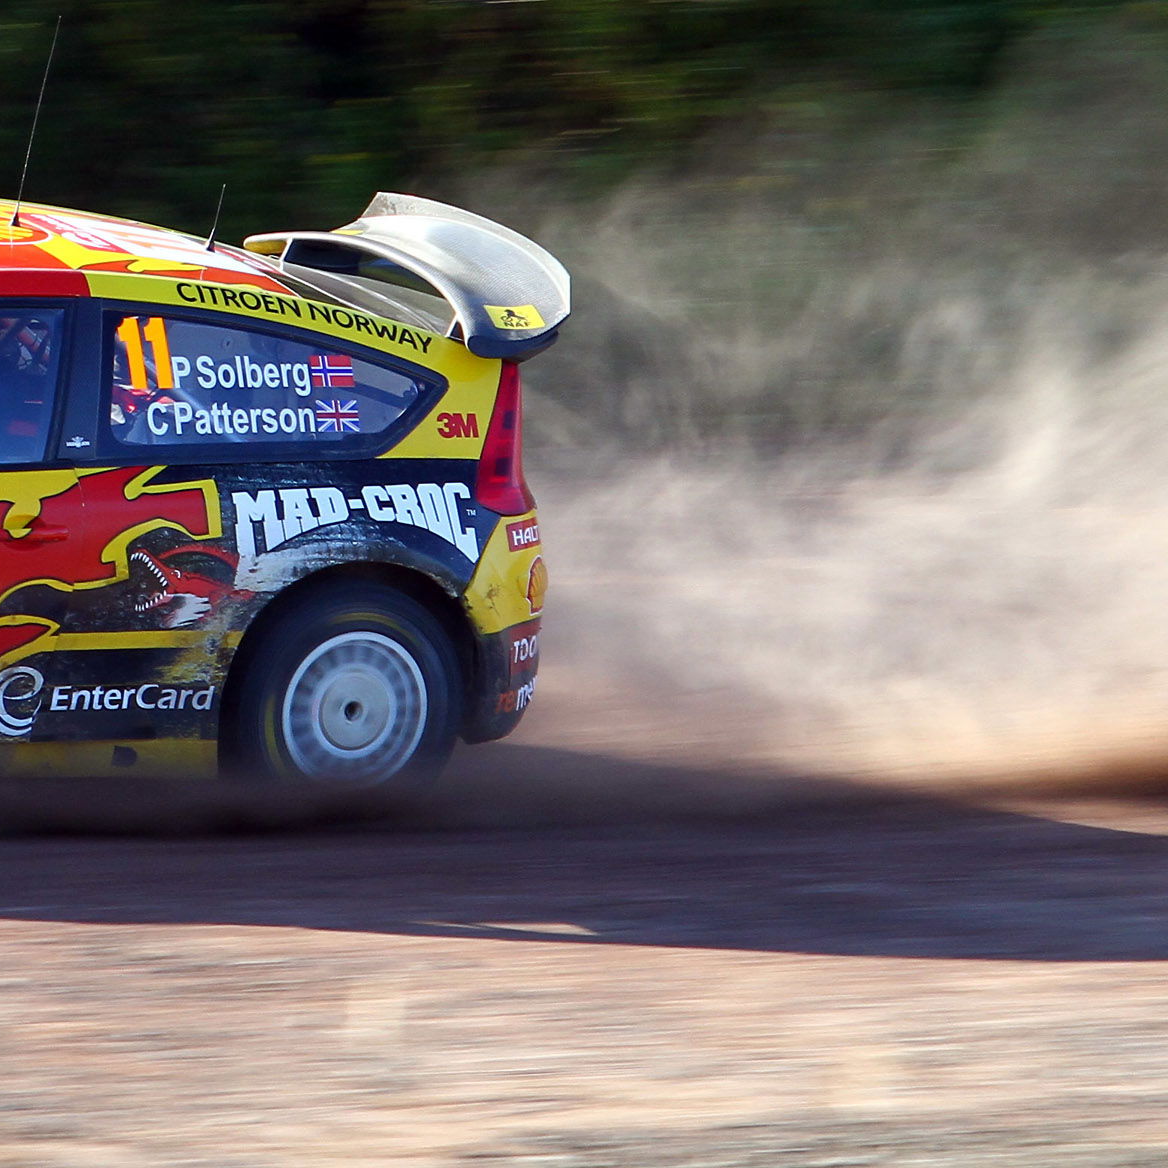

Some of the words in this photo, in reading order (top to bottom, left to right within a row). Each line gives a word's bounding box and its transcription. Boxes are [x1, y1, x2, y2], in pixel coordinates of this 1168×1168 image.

[177, 283, 301, 318] CITROËN
[310, 303, 432, 353] NORWAY
[117, 316, 174, 389] 11
[172, 356, 191, 389] P
[196, 355, 312, 397] Solberg
[147, 403, 169, 436] C
[174, 401, 316, 435] Patterson
[437, 412, 479, 439] 3M
[232, 482, 480, 589] MAD-CROC
[50, 684, 216, 711] EnterCard
